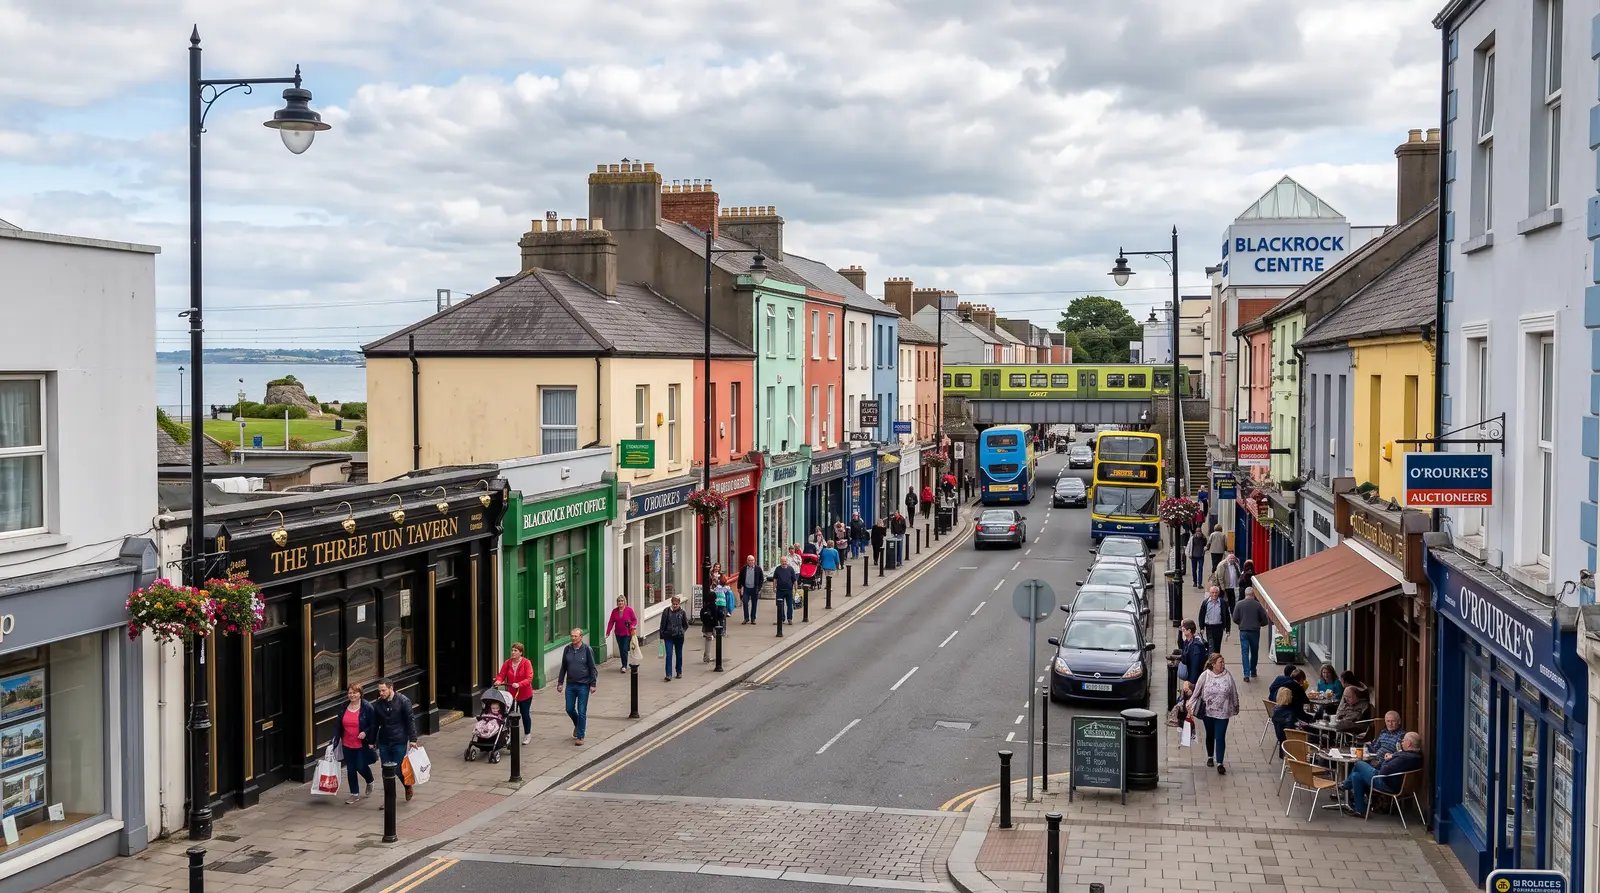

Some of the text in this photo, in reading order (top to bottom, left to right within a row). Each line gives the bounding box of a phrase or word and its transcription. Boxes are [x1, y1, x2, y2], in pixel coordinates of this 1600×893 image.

[1235, 236, 1344, 252] BLACKROCK
[1254, 257, 1325, 272] CENTRE
[1410, 467, 1489, 479] O'ROURKE'S
[644, 491, 680, 512] O'ROURKE'S
[1411, 492, 1487, 502] AUCTIONEERS
[523, 496, 606, 530] BLACKROCK POST OFFICE
[271, 546, 308, 575] THE
[312, 534, 368, 566] THREE
[372, 527, 404, 553] TUN
[406, 516, 460, 545] TAVERN
[1459, 586, 1534, 668] O'ROURKE'S
